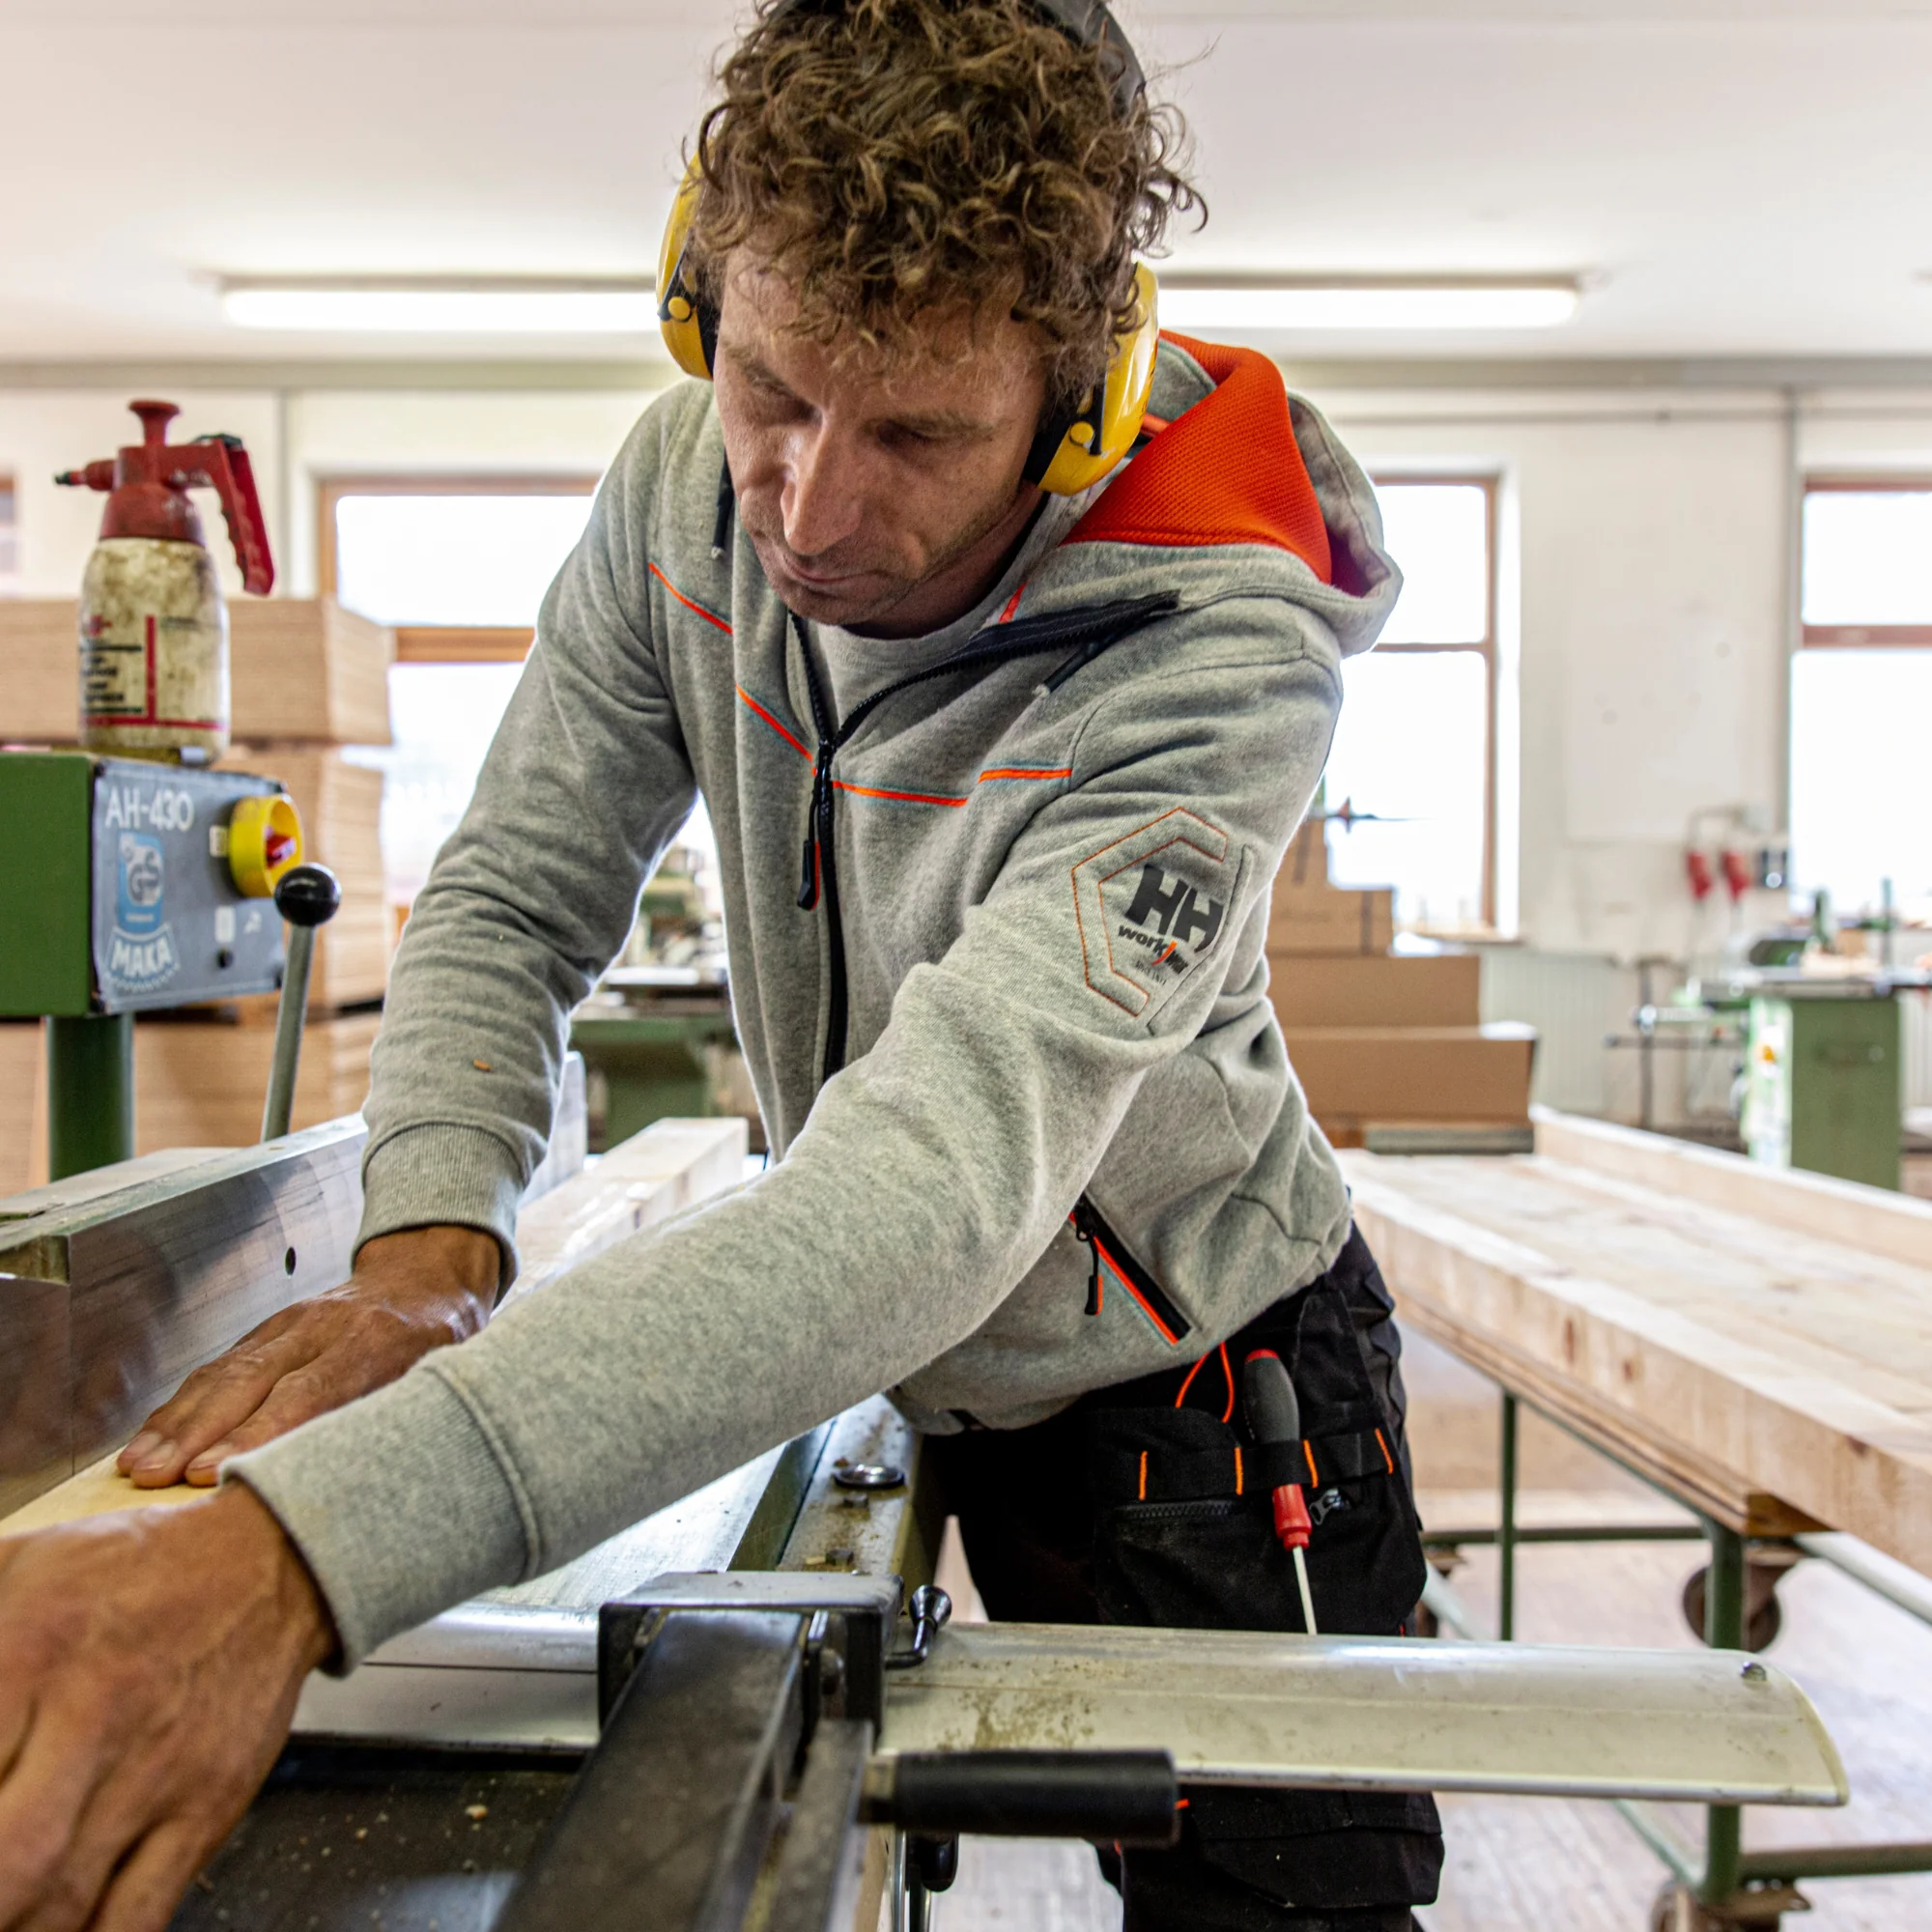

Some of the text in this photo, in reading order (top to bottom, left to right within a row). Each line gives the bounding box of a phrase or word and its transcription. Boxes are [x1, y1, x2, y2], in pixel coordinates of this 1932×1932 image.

[105, 786, 193, 831] AH-430
[1125, 865, 1223, 952] HH
[111, 937, 172, 977] MAKA
